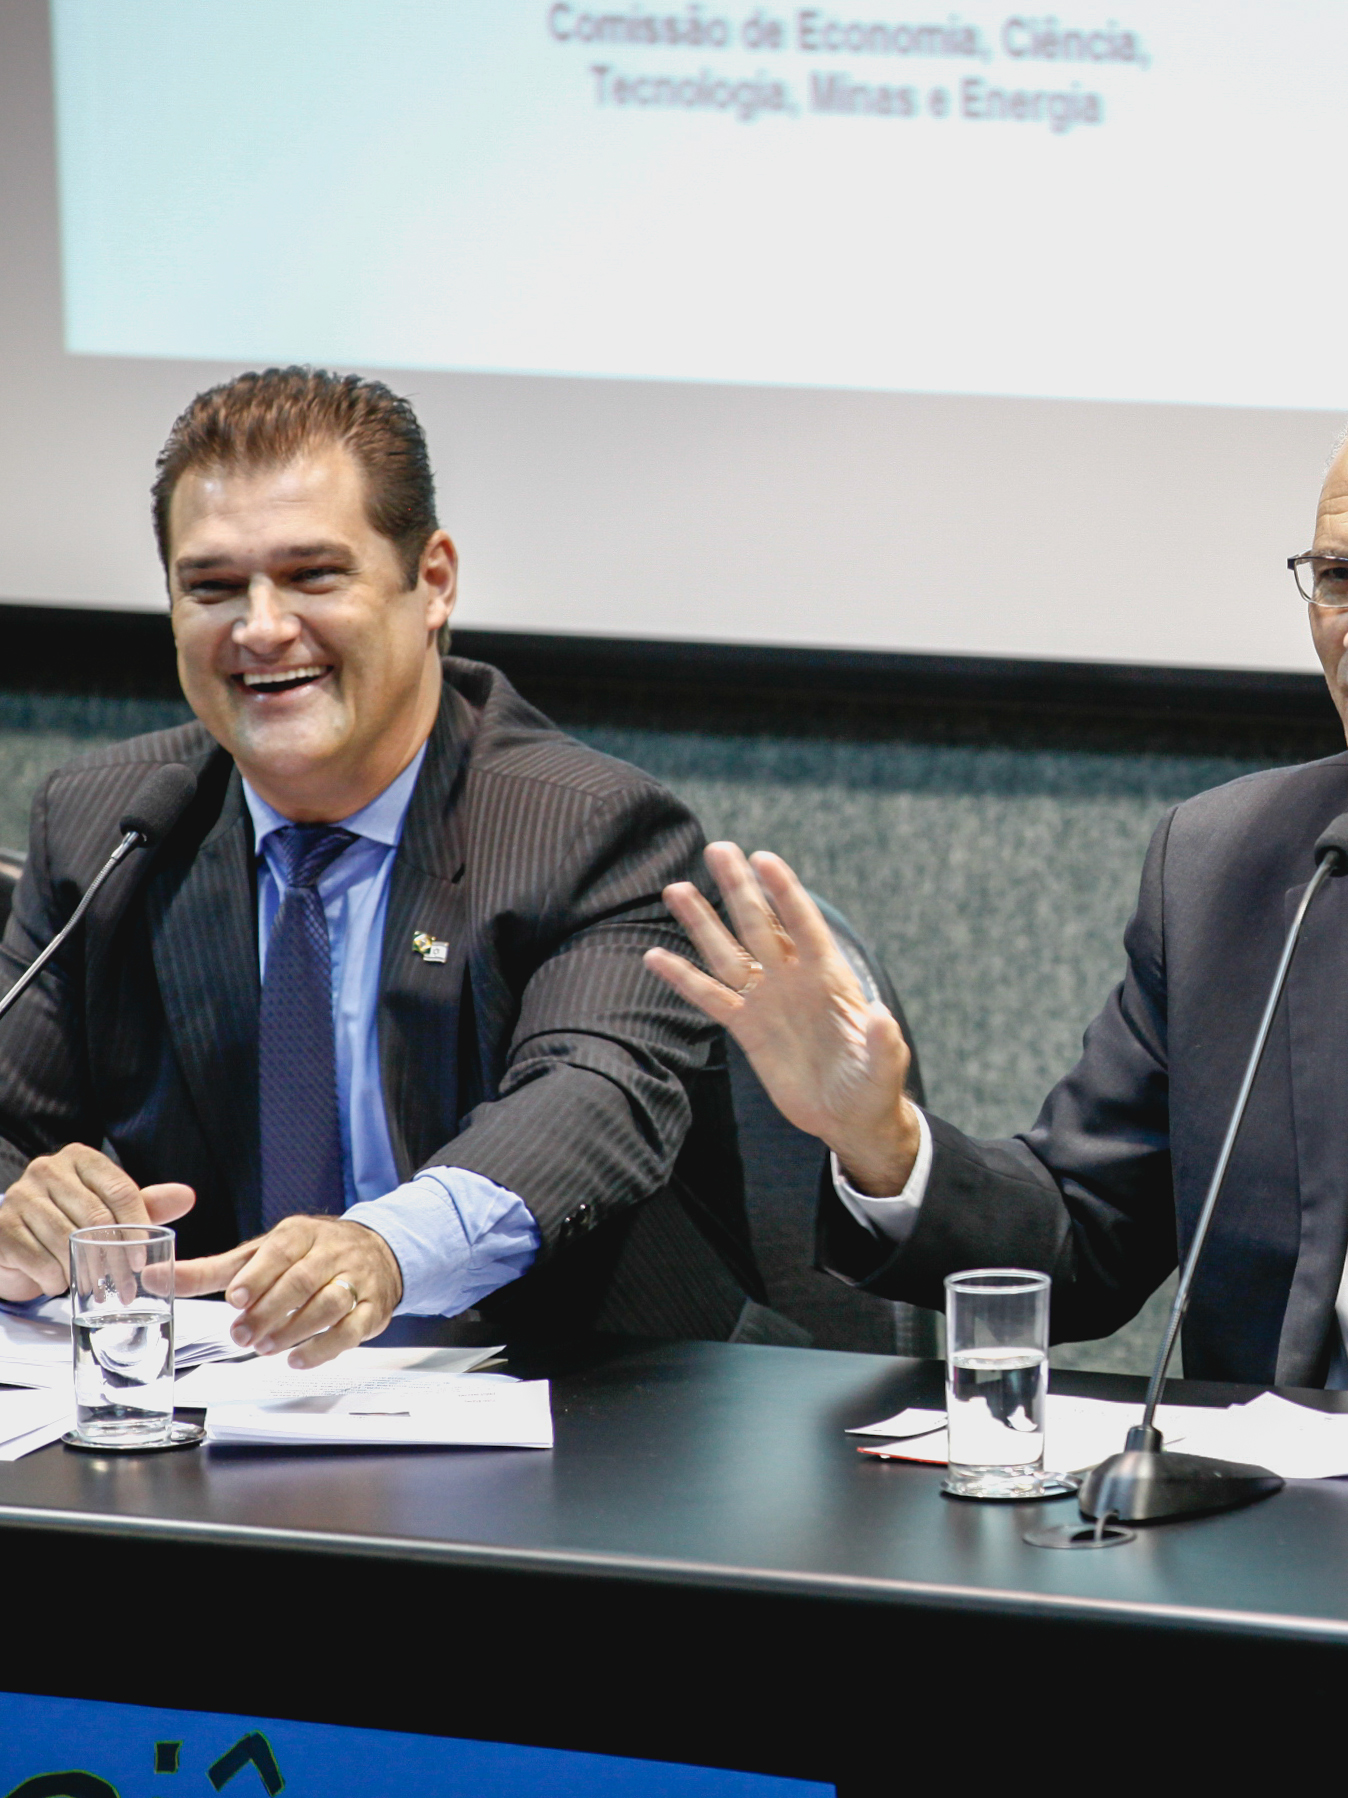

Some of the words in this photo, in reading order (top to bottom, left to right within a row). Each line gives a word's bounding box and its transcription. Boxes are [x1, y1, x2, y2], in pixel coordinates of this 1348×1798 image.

[547, 2, 729, 48] Comissão
[742, 9, 786, 50] de
[797, 10, 992, 64] Economia,
[1001, 16, 1152, 69] Ciência,
[590, 64, 800, 121] Tecnologia,
[810, 70, 915, 117] Minas
[927, 85, 950, 117] e
[961, 76, 1104, 133] Energia
